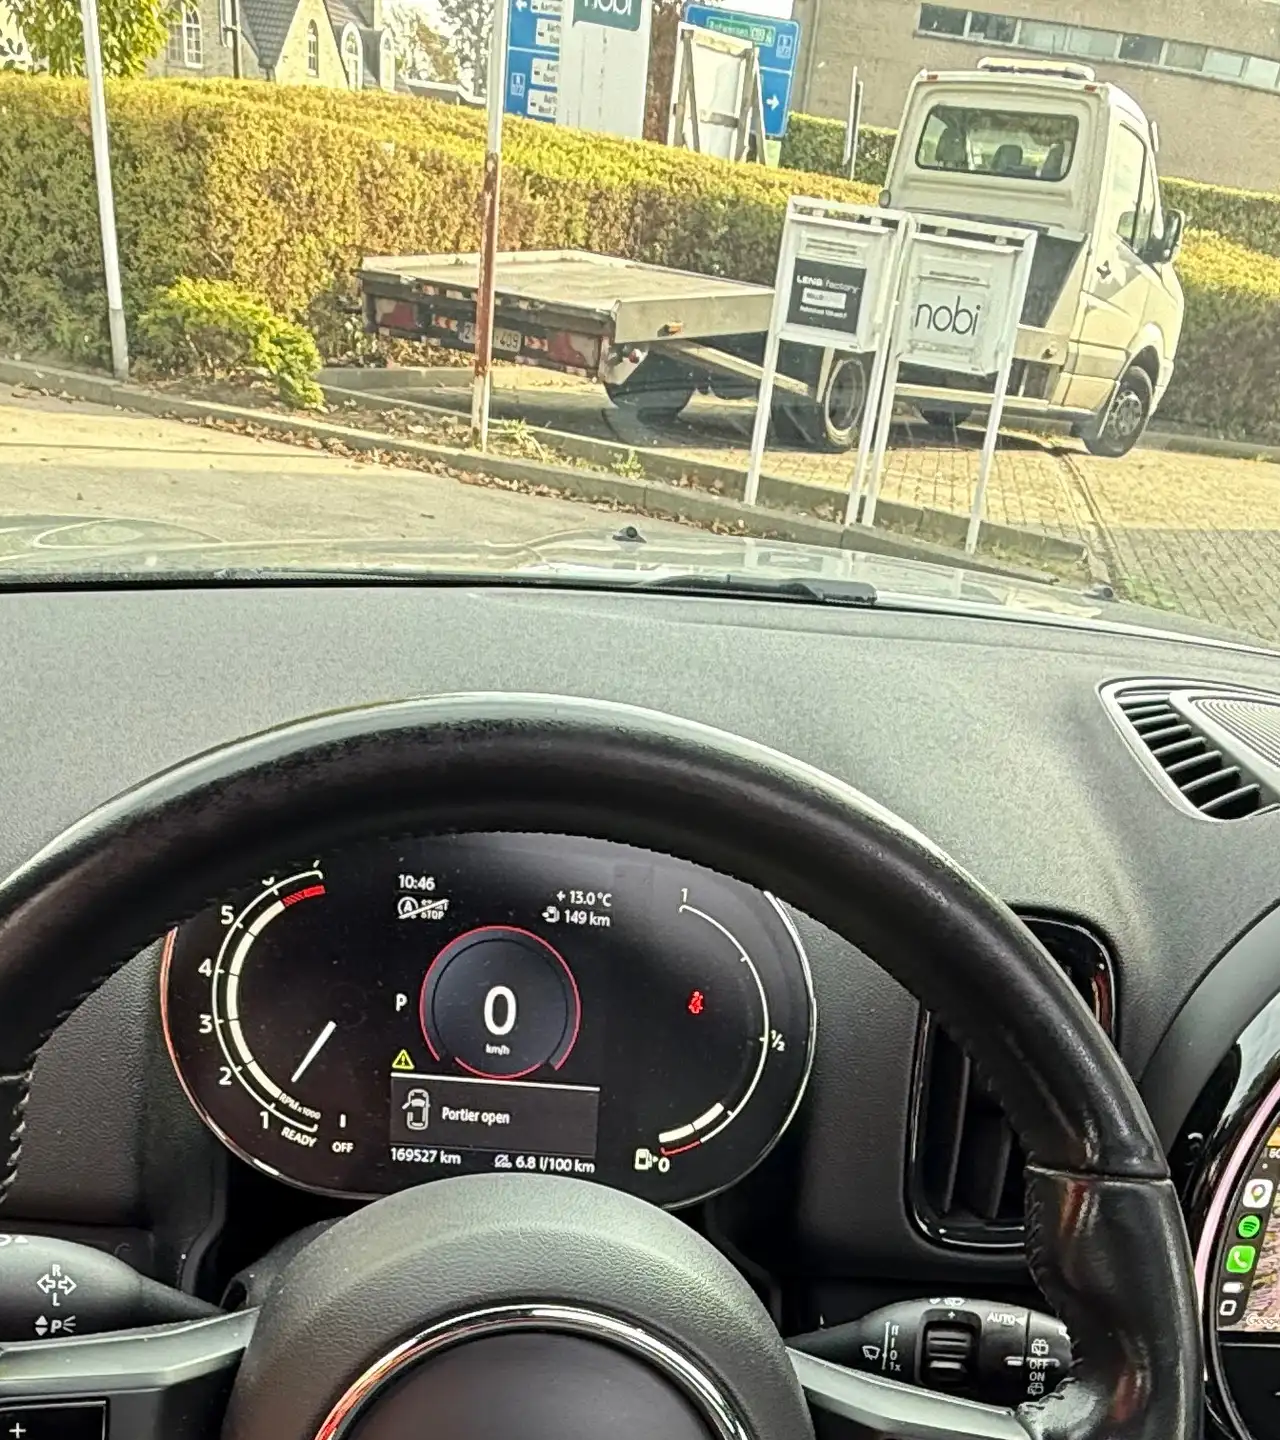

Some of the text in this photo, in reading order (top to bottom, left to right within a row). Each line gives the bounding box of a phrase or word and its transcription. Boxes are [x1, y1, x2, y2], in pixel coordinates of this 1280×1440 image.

[914, 296, 982, 336] nobi
[398, 874, 435, 891] 10:46
[221, 905, 235, 926] 5
[564, 908, 611, 927] 149 km
[198, 958, 213, 978] 4
[395, 993, 408, 1012] P
[483, 985, 517, 1036] 0
[198, 1014, 213, 1033] 3
[486, 1043, 511, 1056] km/h
[219, 1066, 233, 1086] 2
[260, 1111, 269, 1129] 1
[442, 1106, 510, 1127] Portier open
[281, 1126, 318, 1148] READY
[332, 1141, 354, 1154] OFF
[390, 1148, 462, 1165] 169527 km
[516, 1155, 536, 1170] 6.8
[574, 1159, 595, 1174] km
[987, 1312, 1015, 1326] AUTO
[1029, 1371, 1046, 1382] ON
